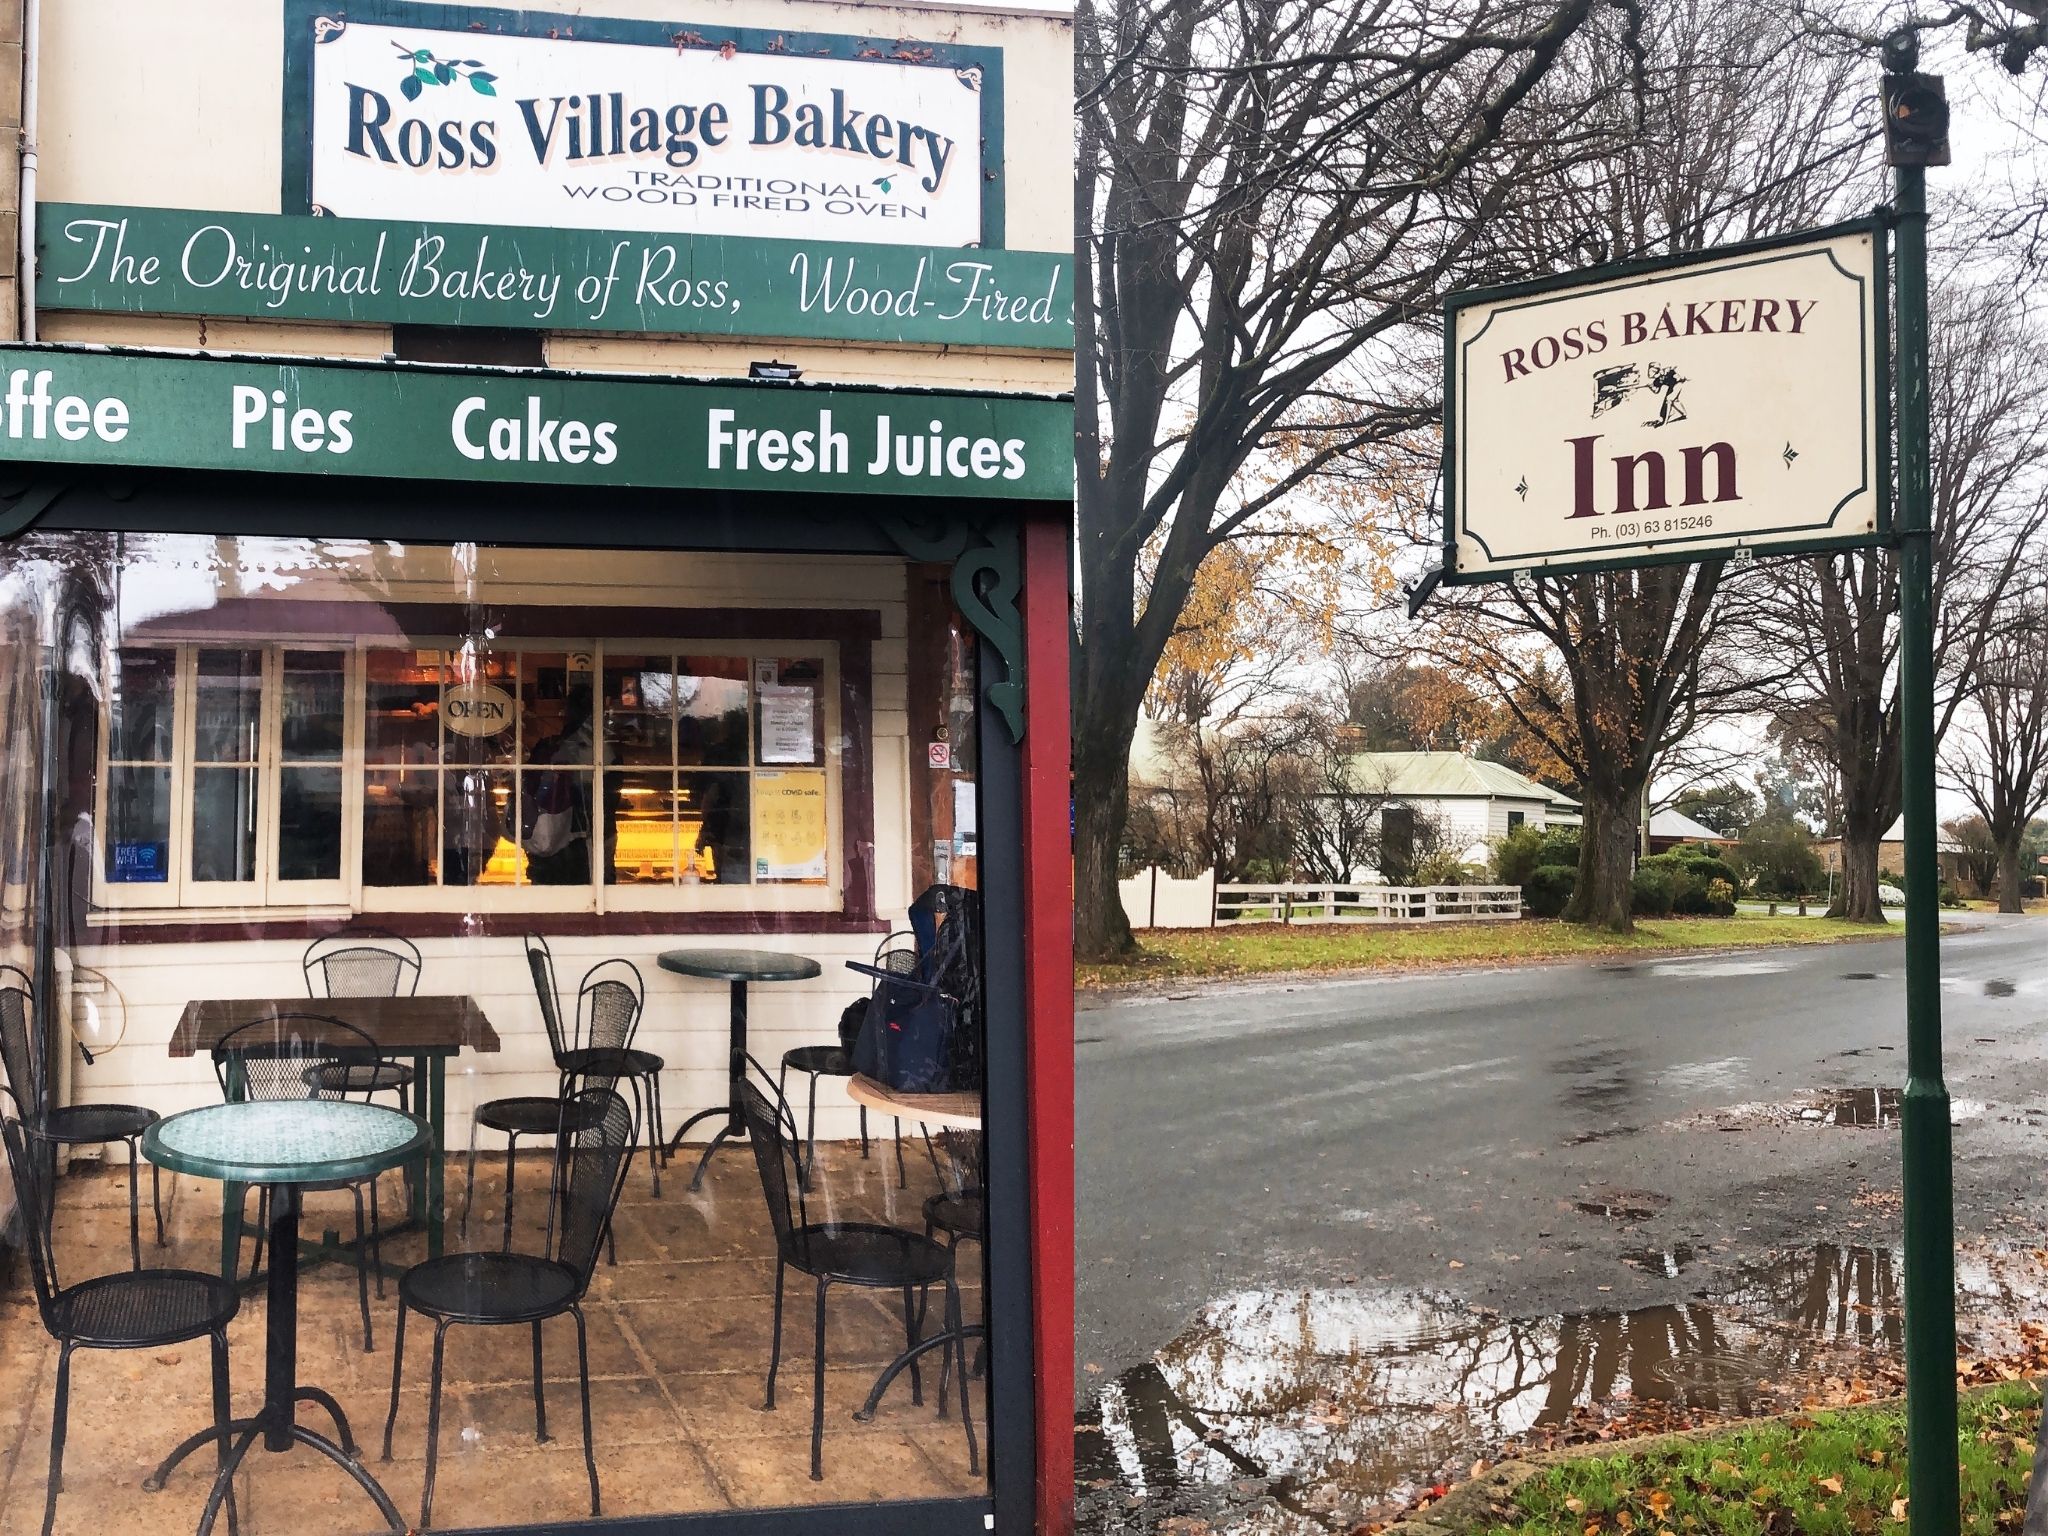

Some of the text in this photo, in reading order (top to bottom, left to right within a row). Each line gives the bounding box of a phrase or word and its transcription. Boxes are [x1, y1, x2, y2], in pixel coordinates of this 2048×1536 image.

[344, 81, 954, 193] Ross Village Bakery
[562, 184, 927, 220] WOOD FIRED OVEN
[627, 170, 868, 198] TRADITIONAL
[57, 218, 1059, 324] The Original Bakery of Ross, Wood-Fired
[1499, 299, 1818, 384] ROSS BAKERY
[0, 368, 1026, 480] ffee Pies Cakes Fresh Juices
[1564, 434, 1743, 520] Inn
[1591, 515, 1713, 540] Ph. (03) 63 815246
[448, 700, 504, 719] OPEN
